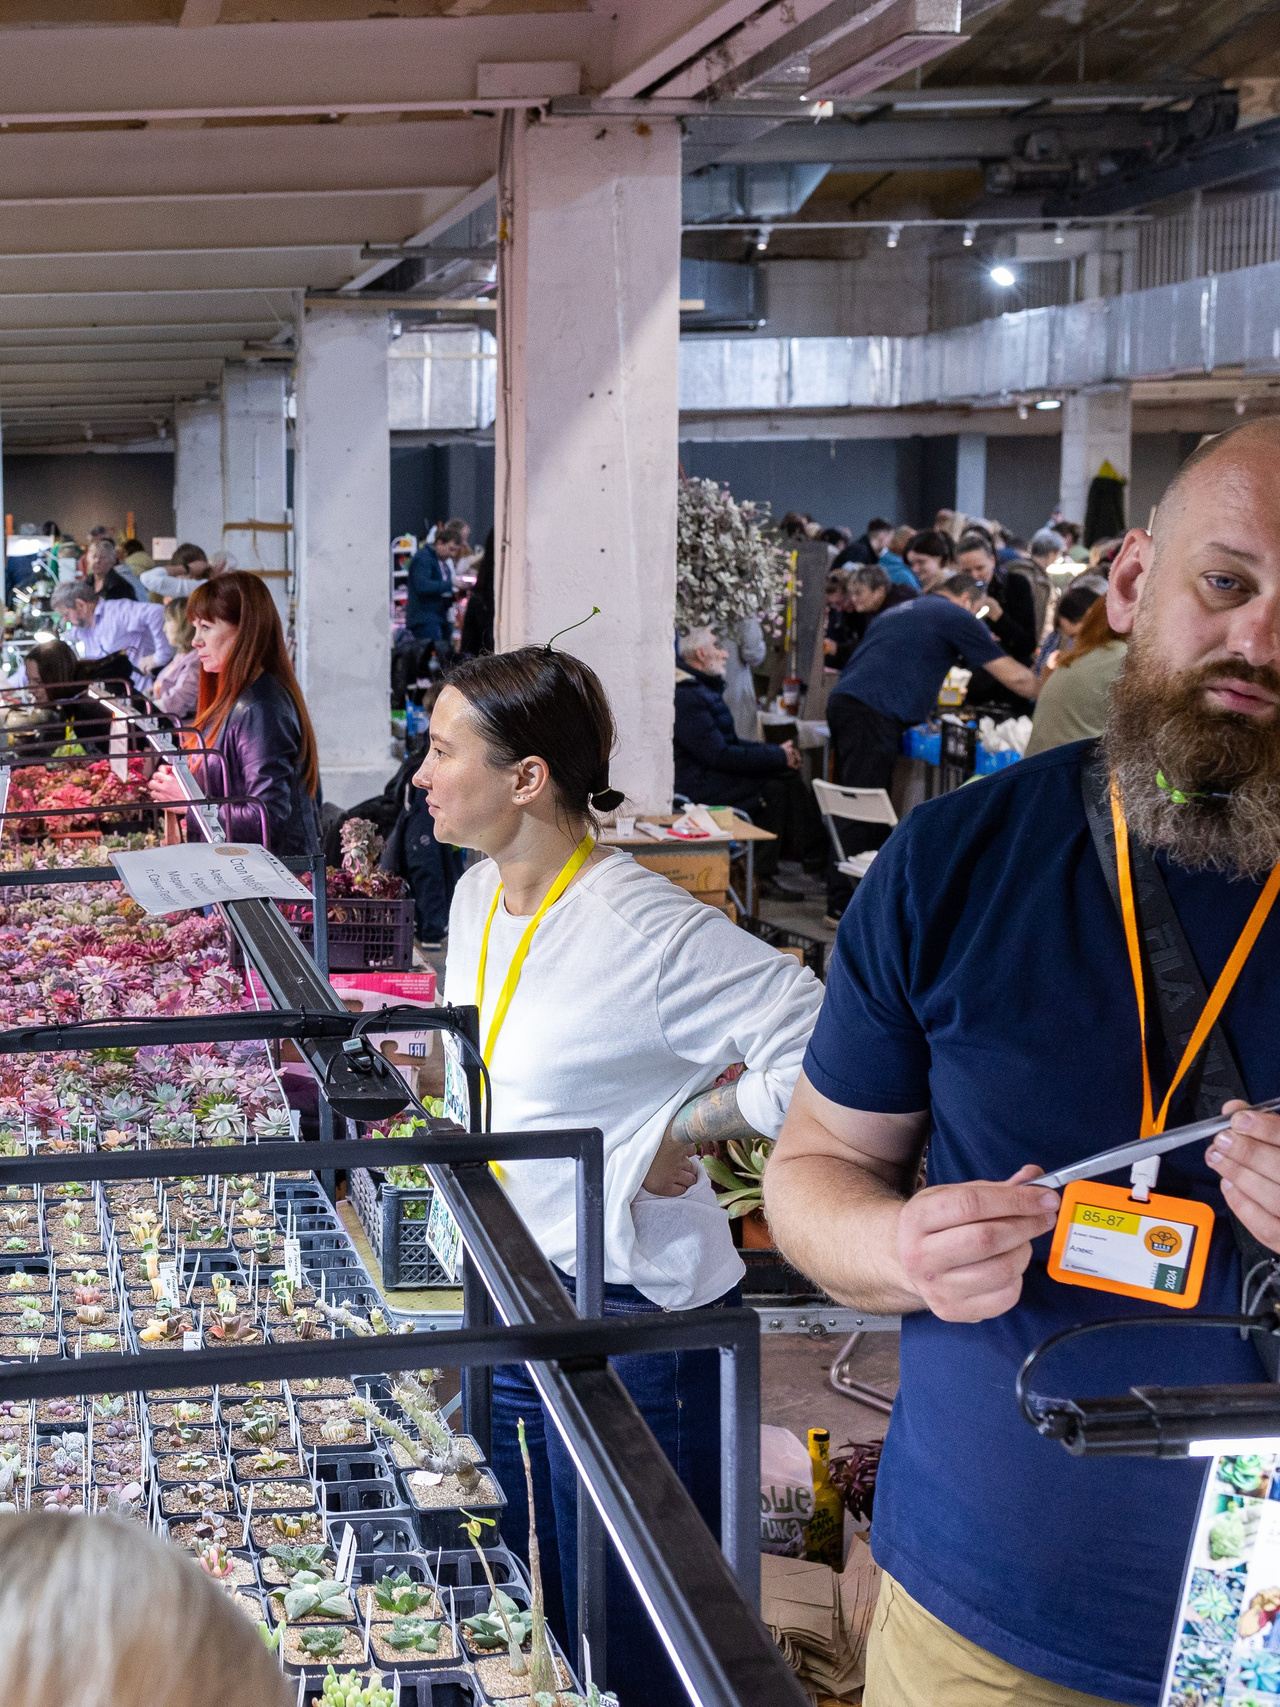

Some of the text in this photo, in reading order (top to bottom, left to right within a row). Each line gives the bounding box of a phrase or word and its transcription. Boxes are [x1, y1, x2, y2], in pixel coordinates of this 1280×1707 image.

[230, 857, 247, 875] Стол
[1143, 920, 1196, 1013] FILA
[1082, 1210, 1125, 1227] 85-87
[1070, 1245, 1094, 1255] Алекс
[1165, 1270, 1177, 1290] 2024
